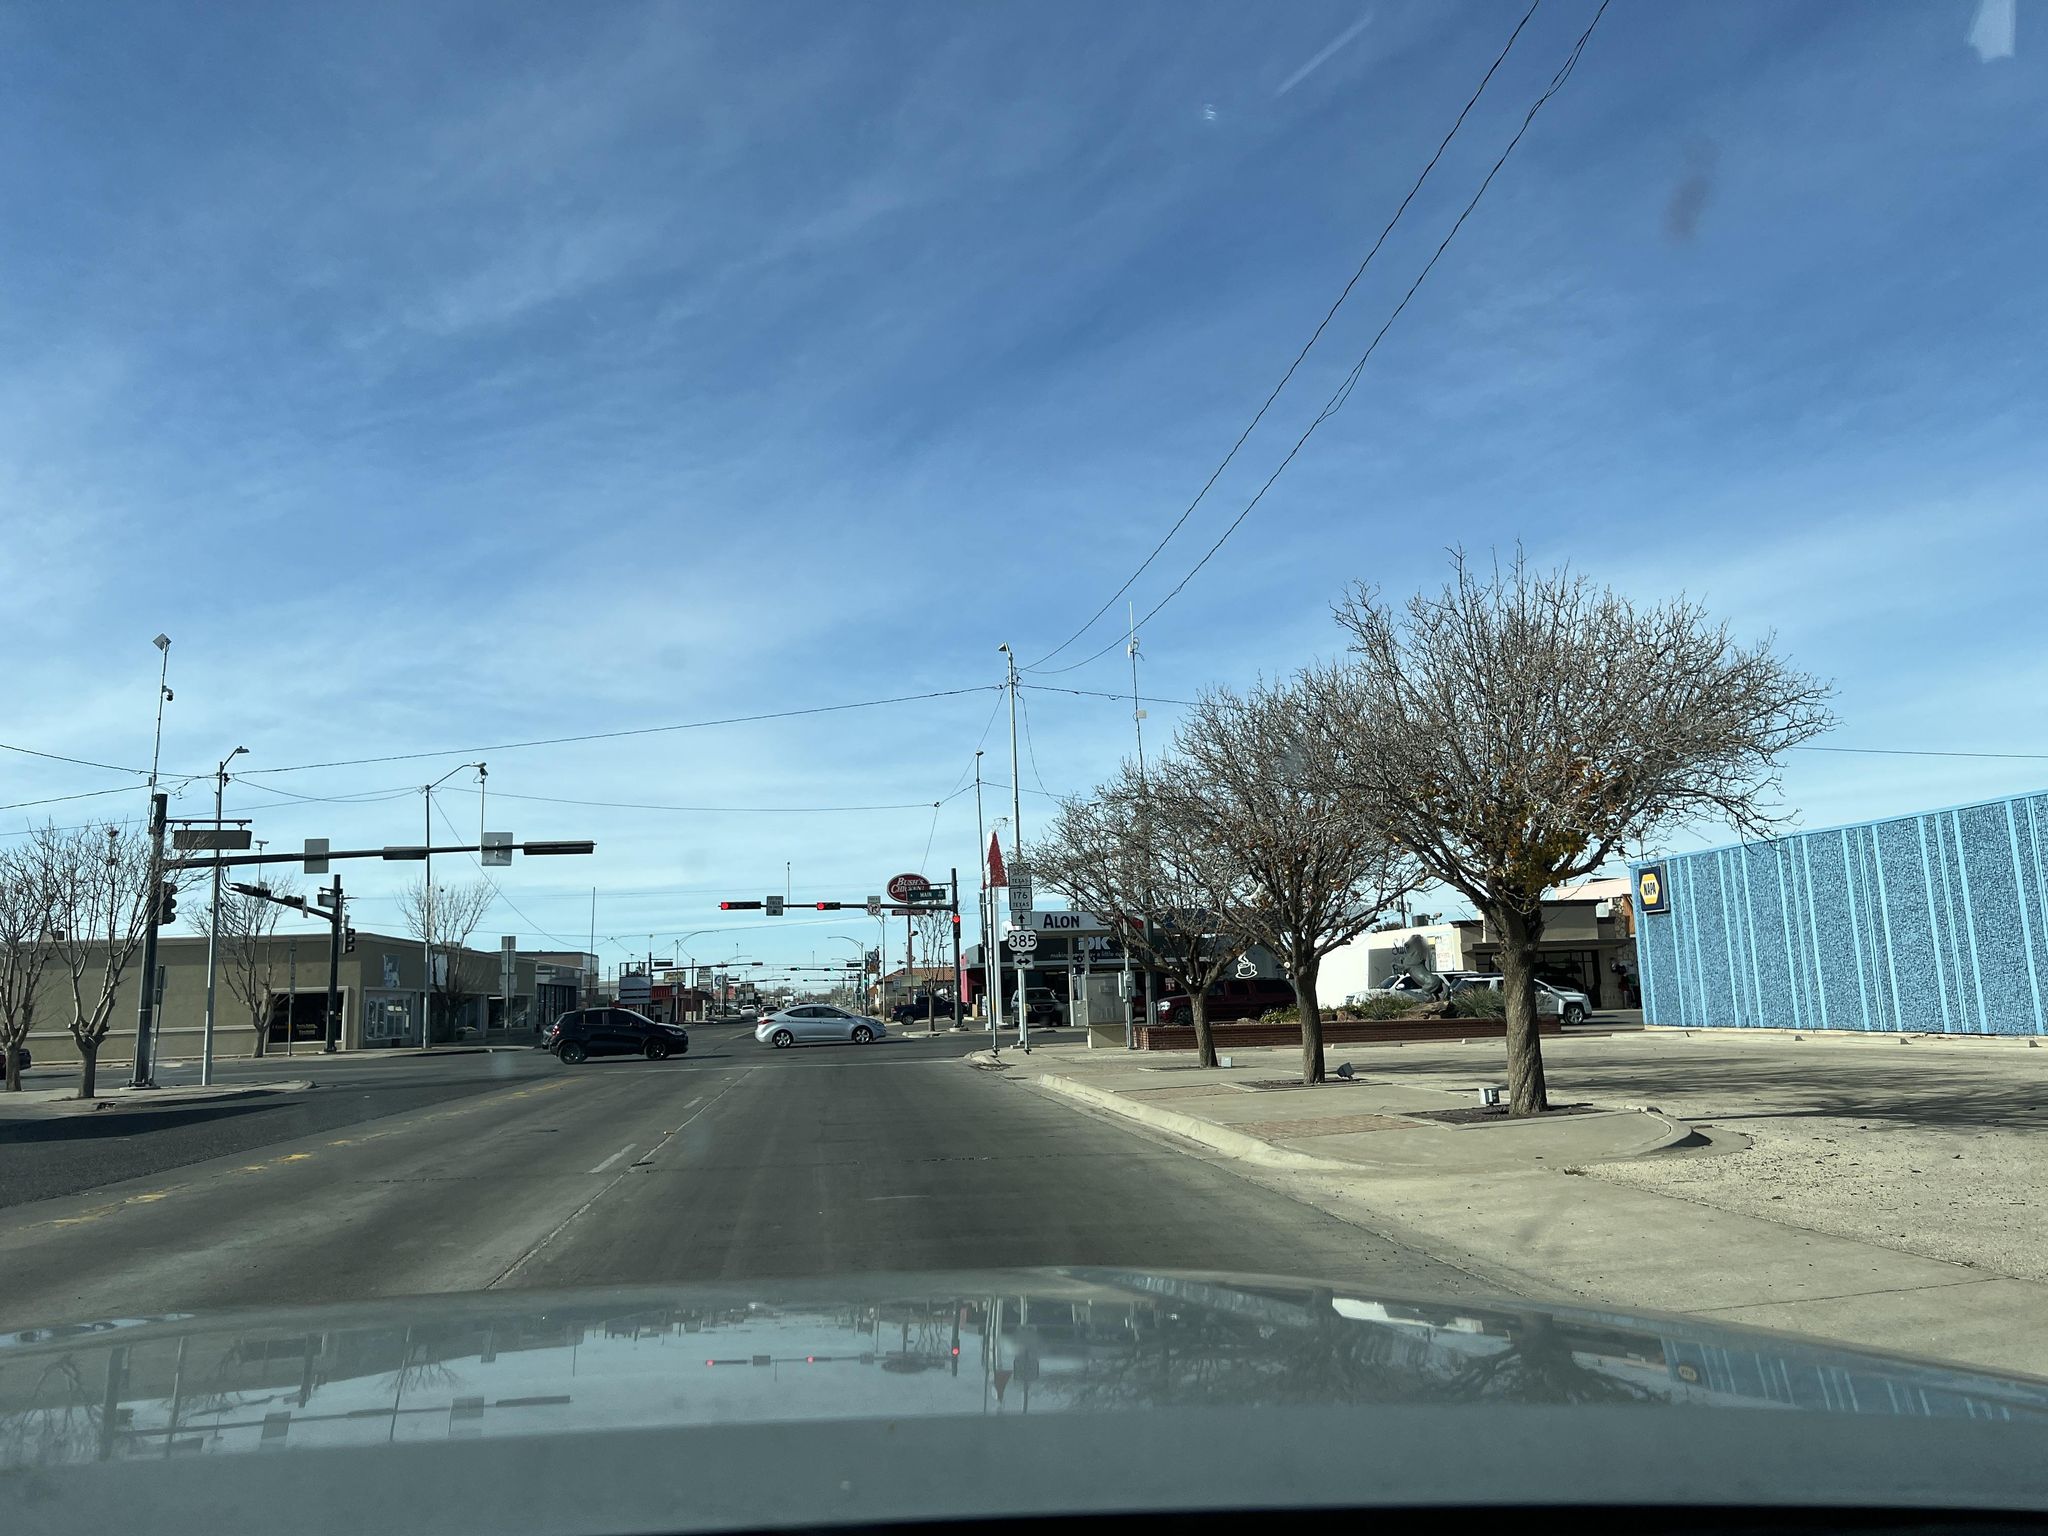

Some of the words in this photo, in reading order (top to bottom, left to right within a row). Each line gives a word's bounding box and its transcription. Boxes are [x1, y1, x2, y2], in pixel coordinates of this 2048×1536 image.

[1013, 891, 1028, 899] 176
[1643, 882, 1657, 896] NAPA
[1009, 934, 1037, 948] 385
